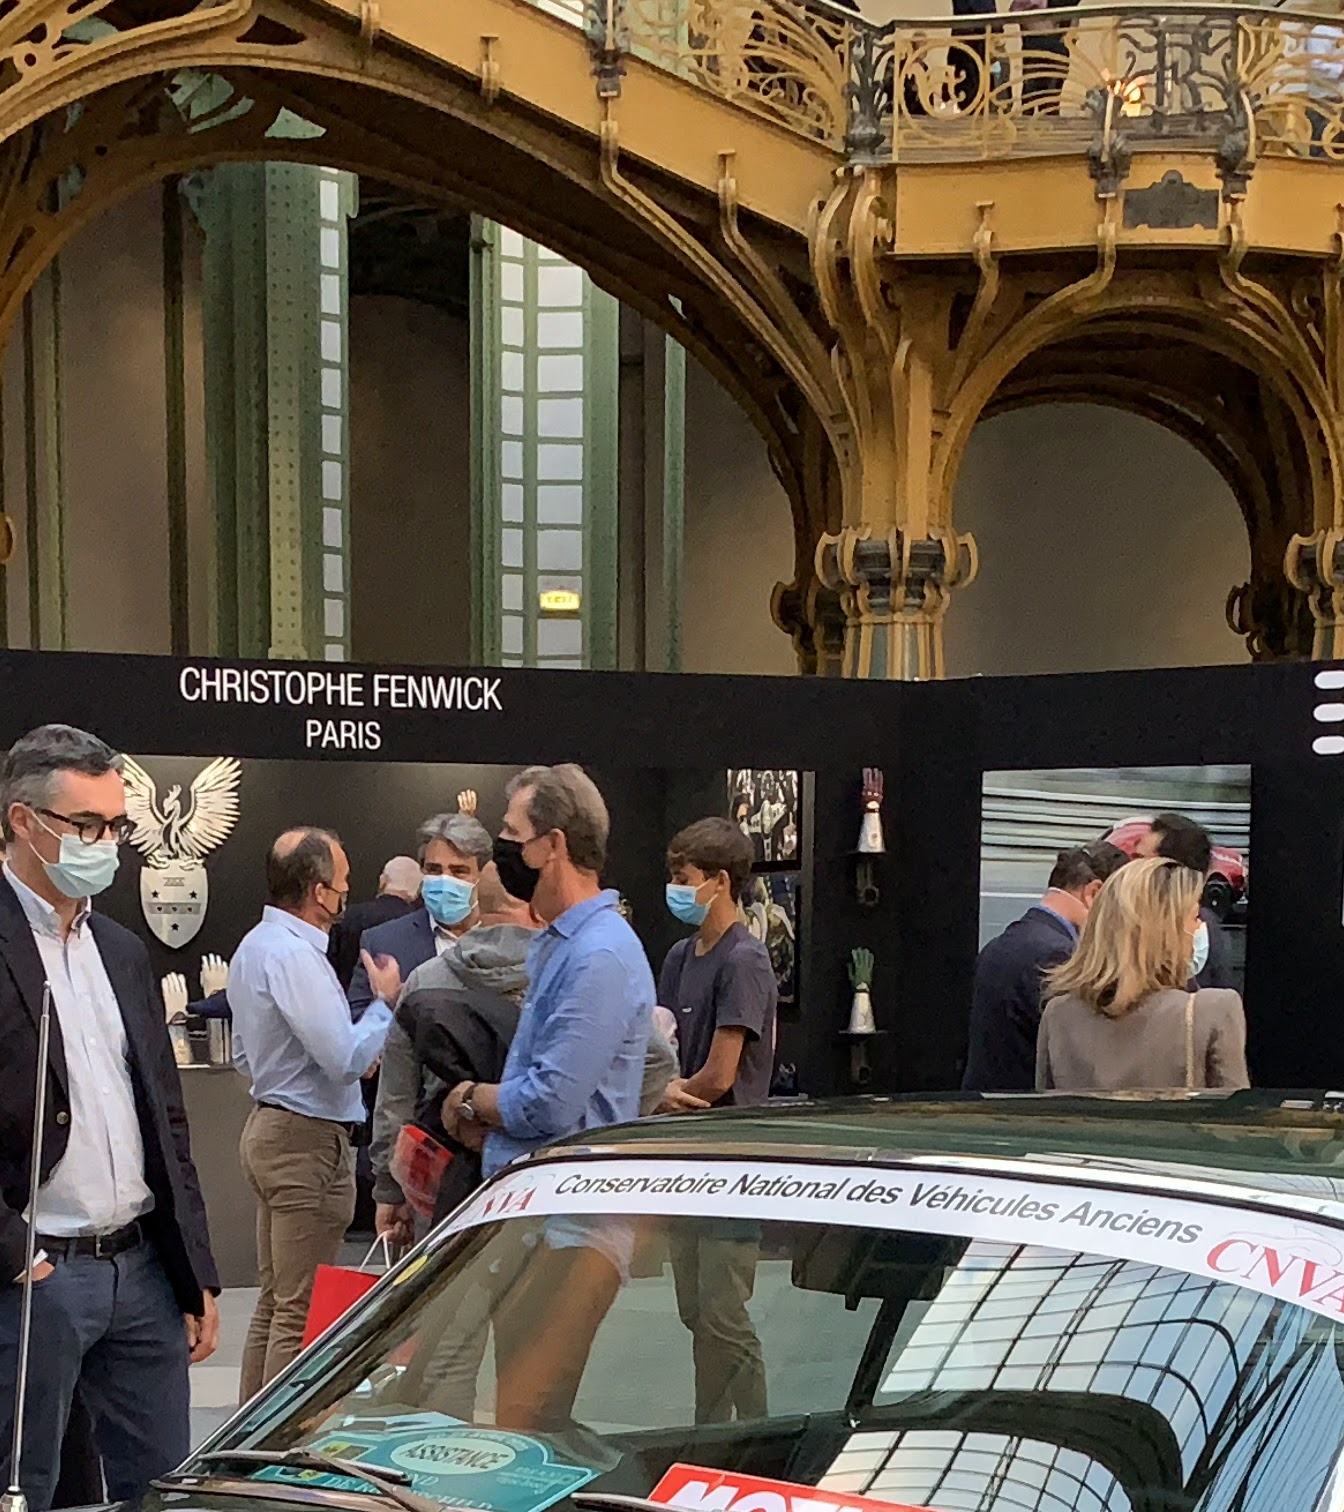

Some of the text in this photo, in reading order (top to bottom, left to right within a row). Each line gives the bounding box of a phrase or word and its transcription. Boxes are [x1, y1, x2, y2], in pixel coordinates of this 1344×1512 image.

[179, 666, 503, 711] CHRISTOPHE FENWICK
[305, 719, 382, 750] PARIS
[554, 1172, 1204, 1245] Conservatoire National des Véhicules Anciens
[402, 1443, 509, 1470] ASSISTANCE
